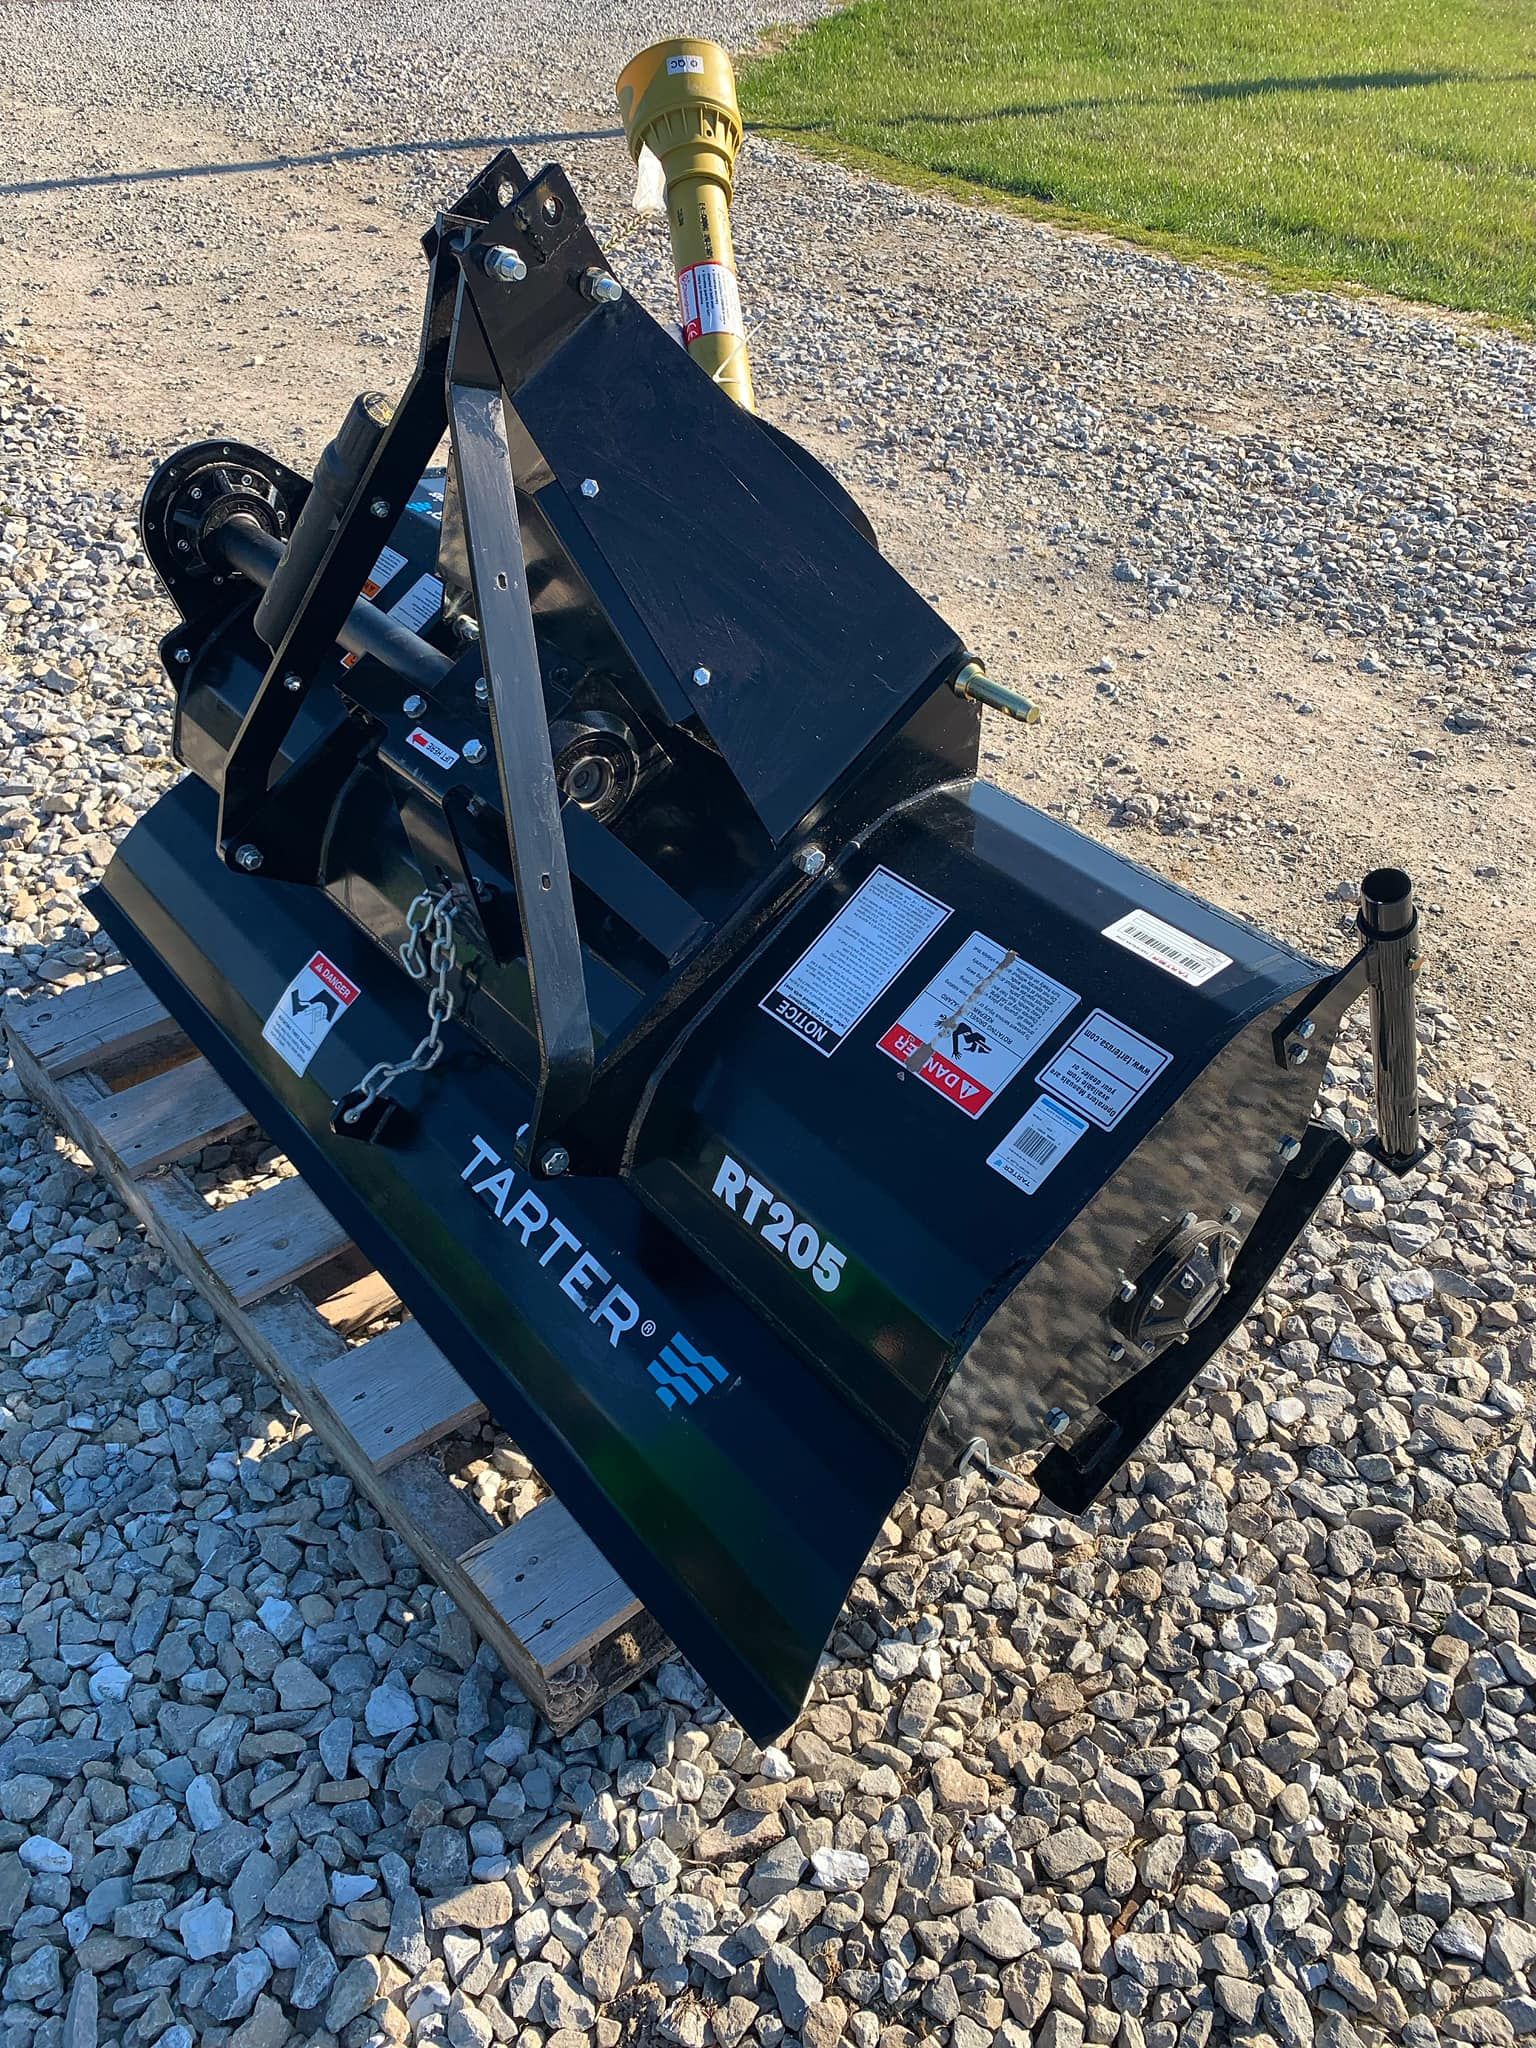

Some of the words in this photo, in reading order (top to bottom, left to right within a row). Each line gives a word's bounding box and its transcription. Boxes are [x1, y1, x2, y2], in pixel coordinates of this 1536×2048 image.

[424, 741, 444, 757] HERE
[438, 751, 455, 765] LIFT
[320, 966, 351, 999] DANGER
[773, 997, 829, 1043] NOTICE
[891, 1033, 961, 1089] DANER
[1081, 1027, 1152, 1077] www.tarterusa.com
[1048, 1067, 1062, 1078] are
[1064, 1068, 1082, 1083] from
[1070, 1062, 1081, 1071] or
[1057, 1074, 1087, 1097] Manuals
[1078, 1078, 1110, 1102] available
[1099, 1081, 1117, 1095] your
[1083, 1091, 1118, 1118] Operators
[1002, 1162, 1032, 1188] TARTER
[711, 1154, 848, 1293] RT205
[460, 1133, 641, 1349] TARTER
